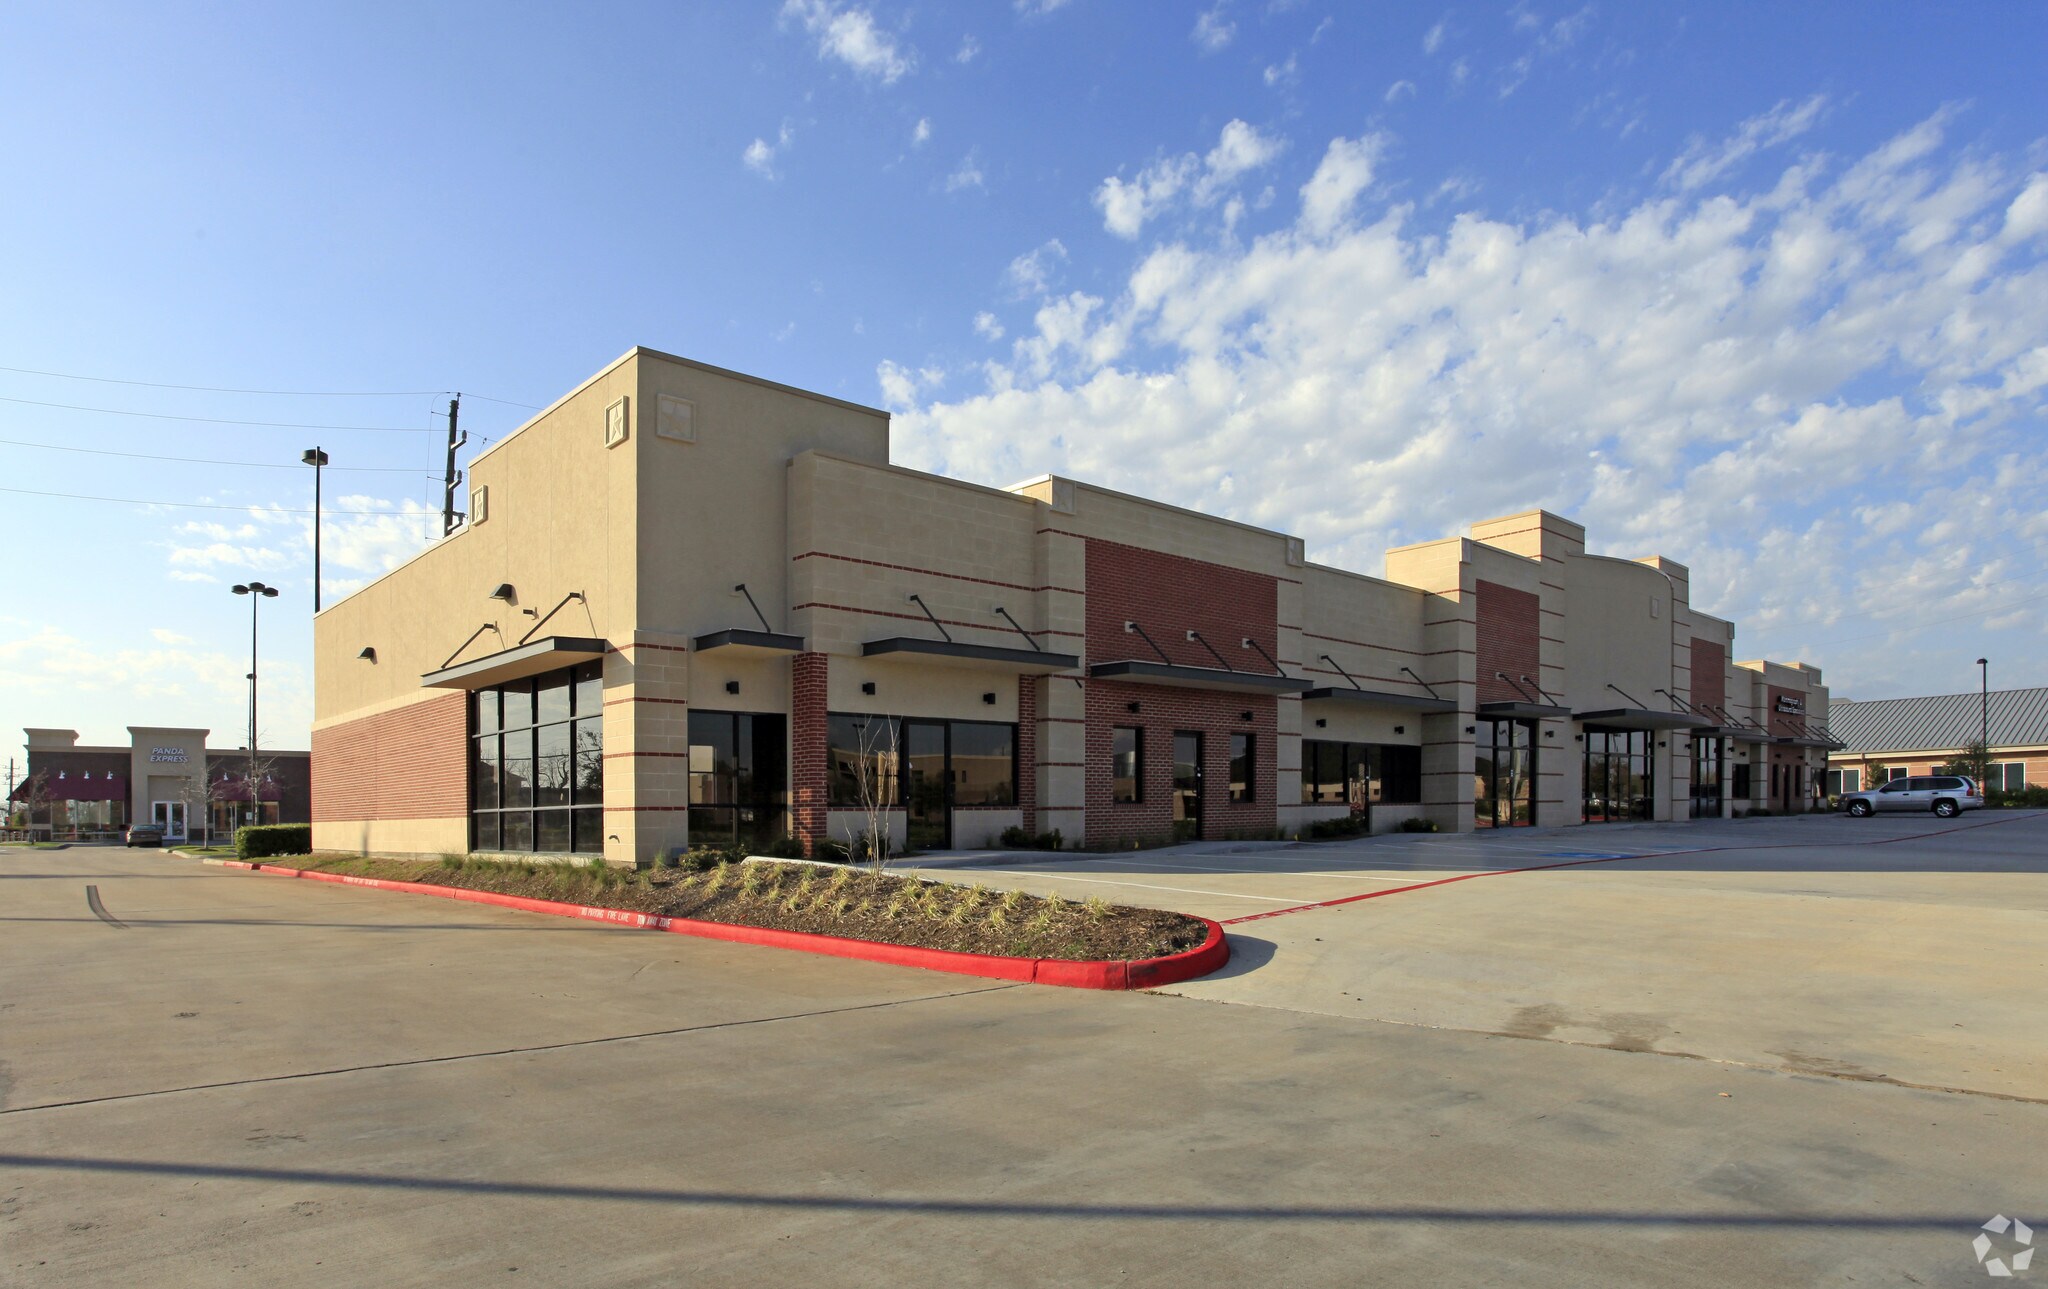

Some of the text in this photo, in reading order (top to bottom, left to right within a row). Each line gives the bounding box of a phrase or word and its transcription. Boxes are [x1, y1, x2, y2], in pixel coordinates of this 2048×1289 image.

[152, 747, 184, 755] PANDA
[150, 755, 189, 763] EXPRESS
[659, 917, 672, 929] ZONE
